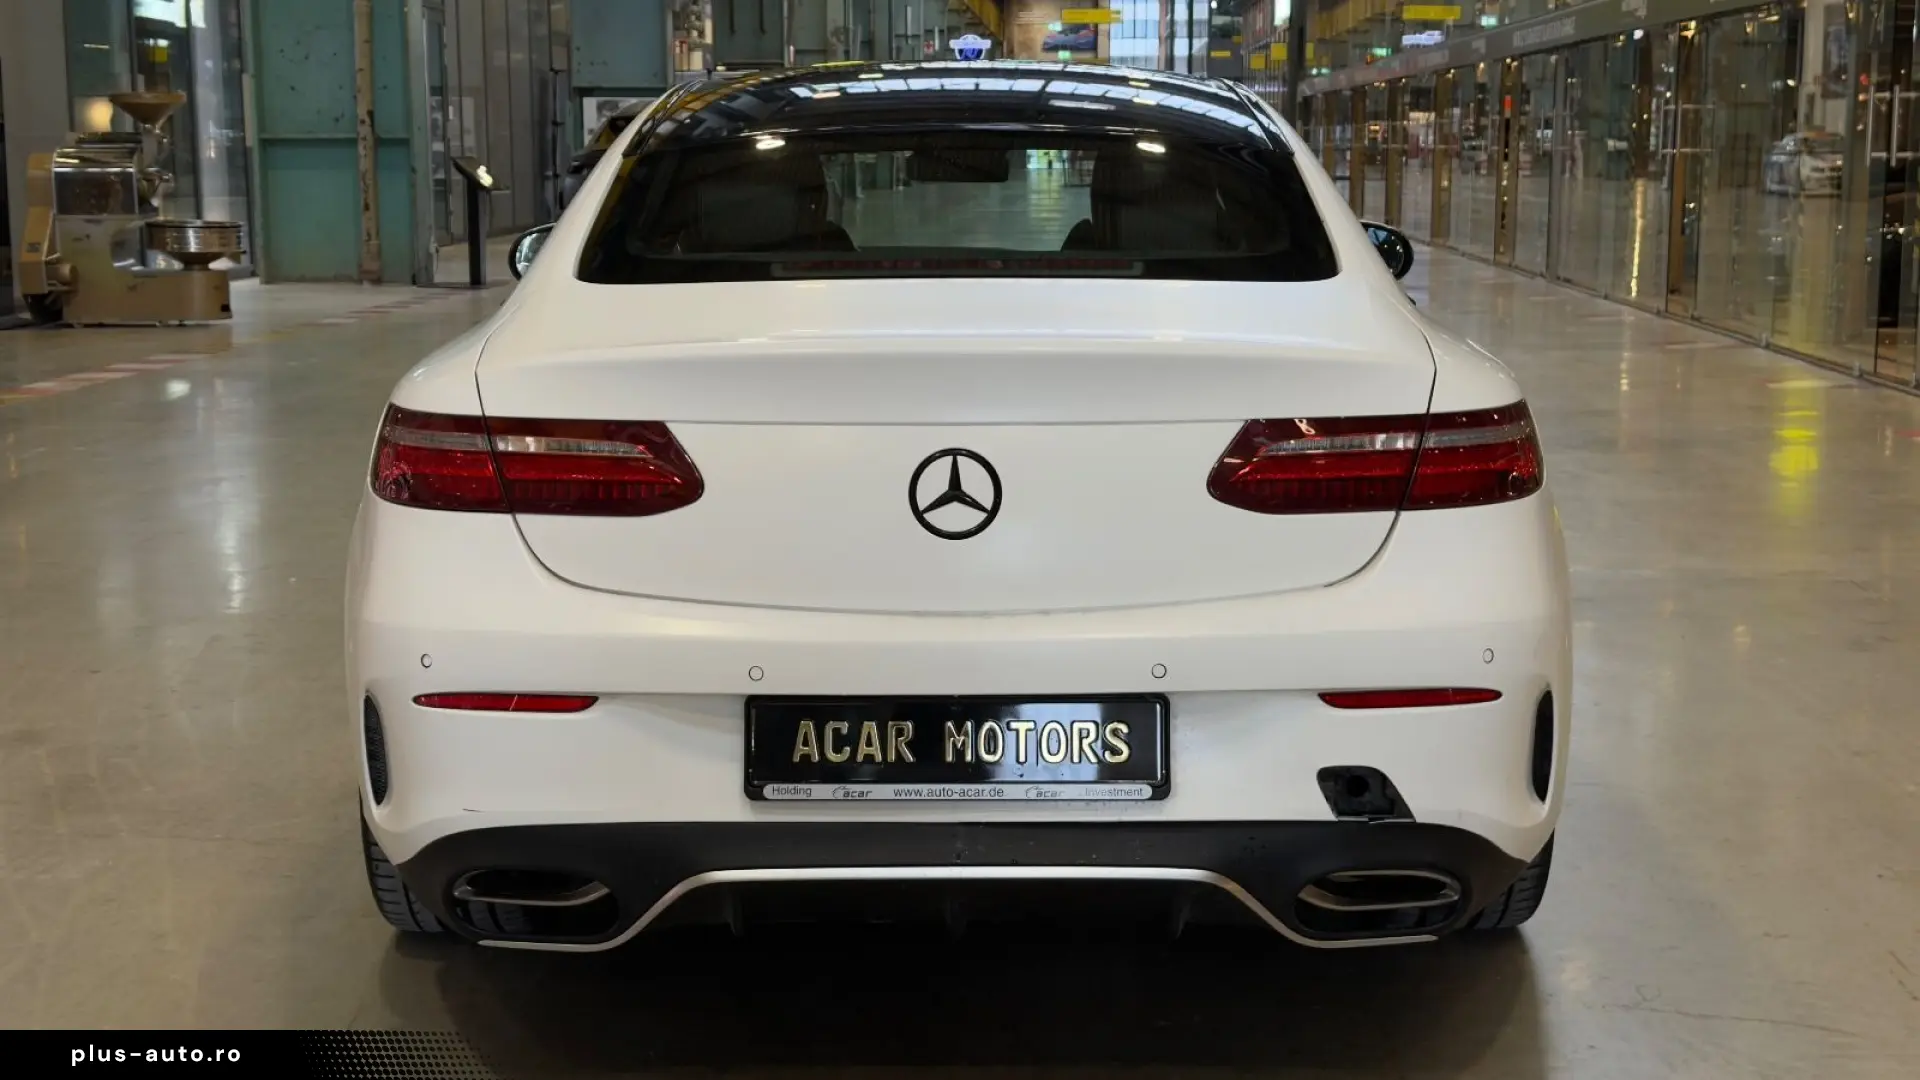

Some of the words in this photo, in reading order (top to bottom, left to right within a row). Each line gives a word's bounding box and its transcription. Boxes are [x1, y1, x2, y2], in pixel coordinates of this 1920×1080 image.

[792, 719, 916, 763] ACAR
[944, 719, 1132, 764] MOTORS
[772, 785, 812, 798] Holding
[842, 788, 873, 798] acar
[893, 786, 1004, 798] www.auto-acar.de
[1085, 786, 1144, 798] Investment
